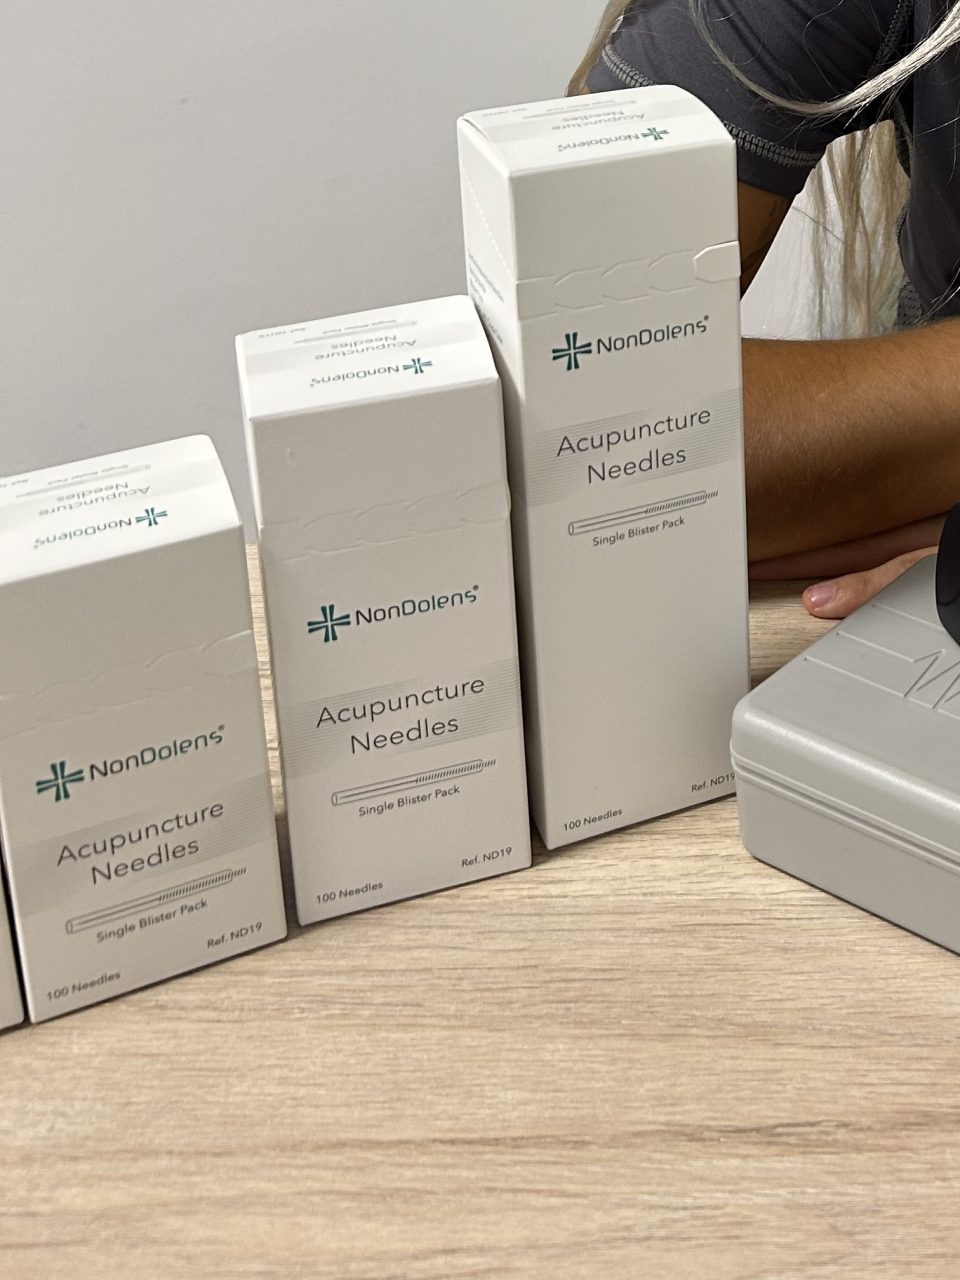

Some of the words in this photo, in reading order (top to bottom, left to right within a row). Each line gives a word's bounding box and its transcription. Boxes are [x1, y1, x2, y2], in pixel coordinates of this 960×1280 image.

[315, 338, 417, 360] Acupuncture
[330, 334, 397, 349] Needles
[556, 407, 711, 457] Acupuncture
[587, 447, 687, 484] Needles
[38, 486, 150, 517] Acupuncture
[56, 481, 129, 502] Needles
[592, 531, 626, 548] Single
[628, 522, 660, 539] Blister
[661, 516, 685, 531] Pack
[316, 678, 485, 728] Acupuncture
[351, 716, 459, 755] Needles
[358, 800, 394, 817] Single
[397, 791, 432, 808] Blister
[434, 785, 460, 801] Pack
[691, 781, 708, 792] Ref.
[57, 803, 225, 866] Acupuncture
[563, 818, 581, 831] 100
[583, 808, 623, 826] Needles
[91, 839, 200, 885] Needles
[461, 854, 481, 868] Ref.
[483, 847, 513, 862] ND19
[316, 892, 336, 904] 100
[339, 881, 383, 899] Needles
[96, 922, 136, 943] Single
[139, 909, 177, 929] Blister
[180, 898, 208, 916] Pack
[207, 933, 229, 949] Ref.
[230, 922, 263, 942] ND19
[46, 987, 69, 1001] 100
[71, 971, 121, 994] Needles
